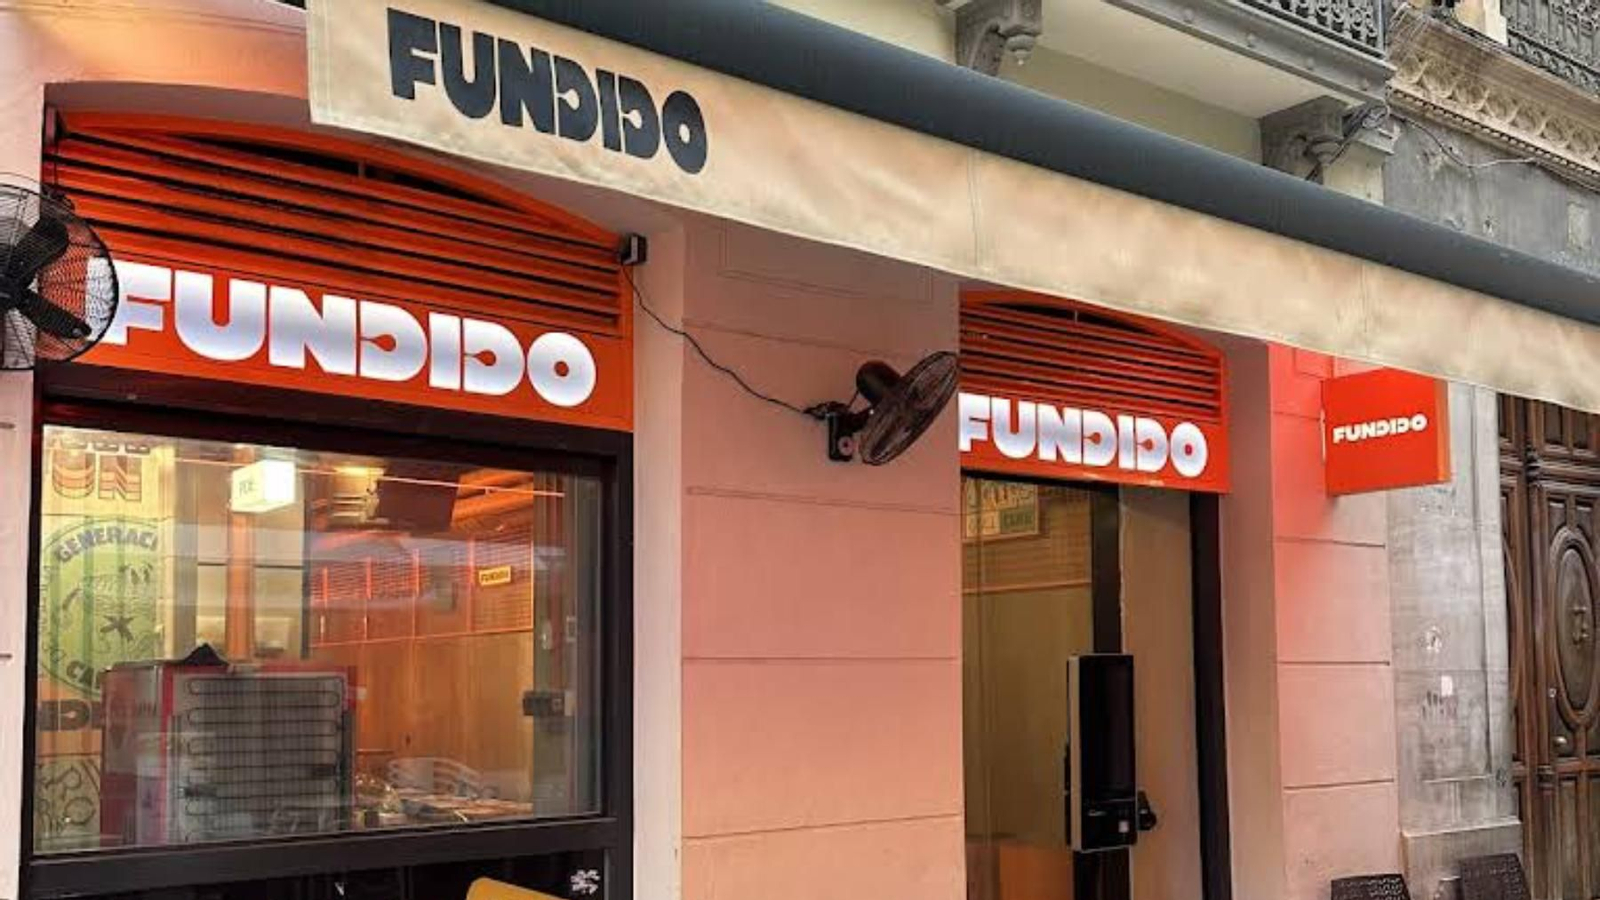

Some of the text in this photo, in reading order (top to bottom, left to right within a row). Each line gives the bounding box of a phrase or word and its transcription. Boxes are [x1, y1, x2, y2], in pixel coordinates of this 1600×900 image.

[387, 8, 707, 174] FUNDIDO
[86, 257, 596, 407] FUNDIDO
[958, 392, 1208, 478] FUNDIDO
[1332, 413, 1428, 444] FUNDIDO
